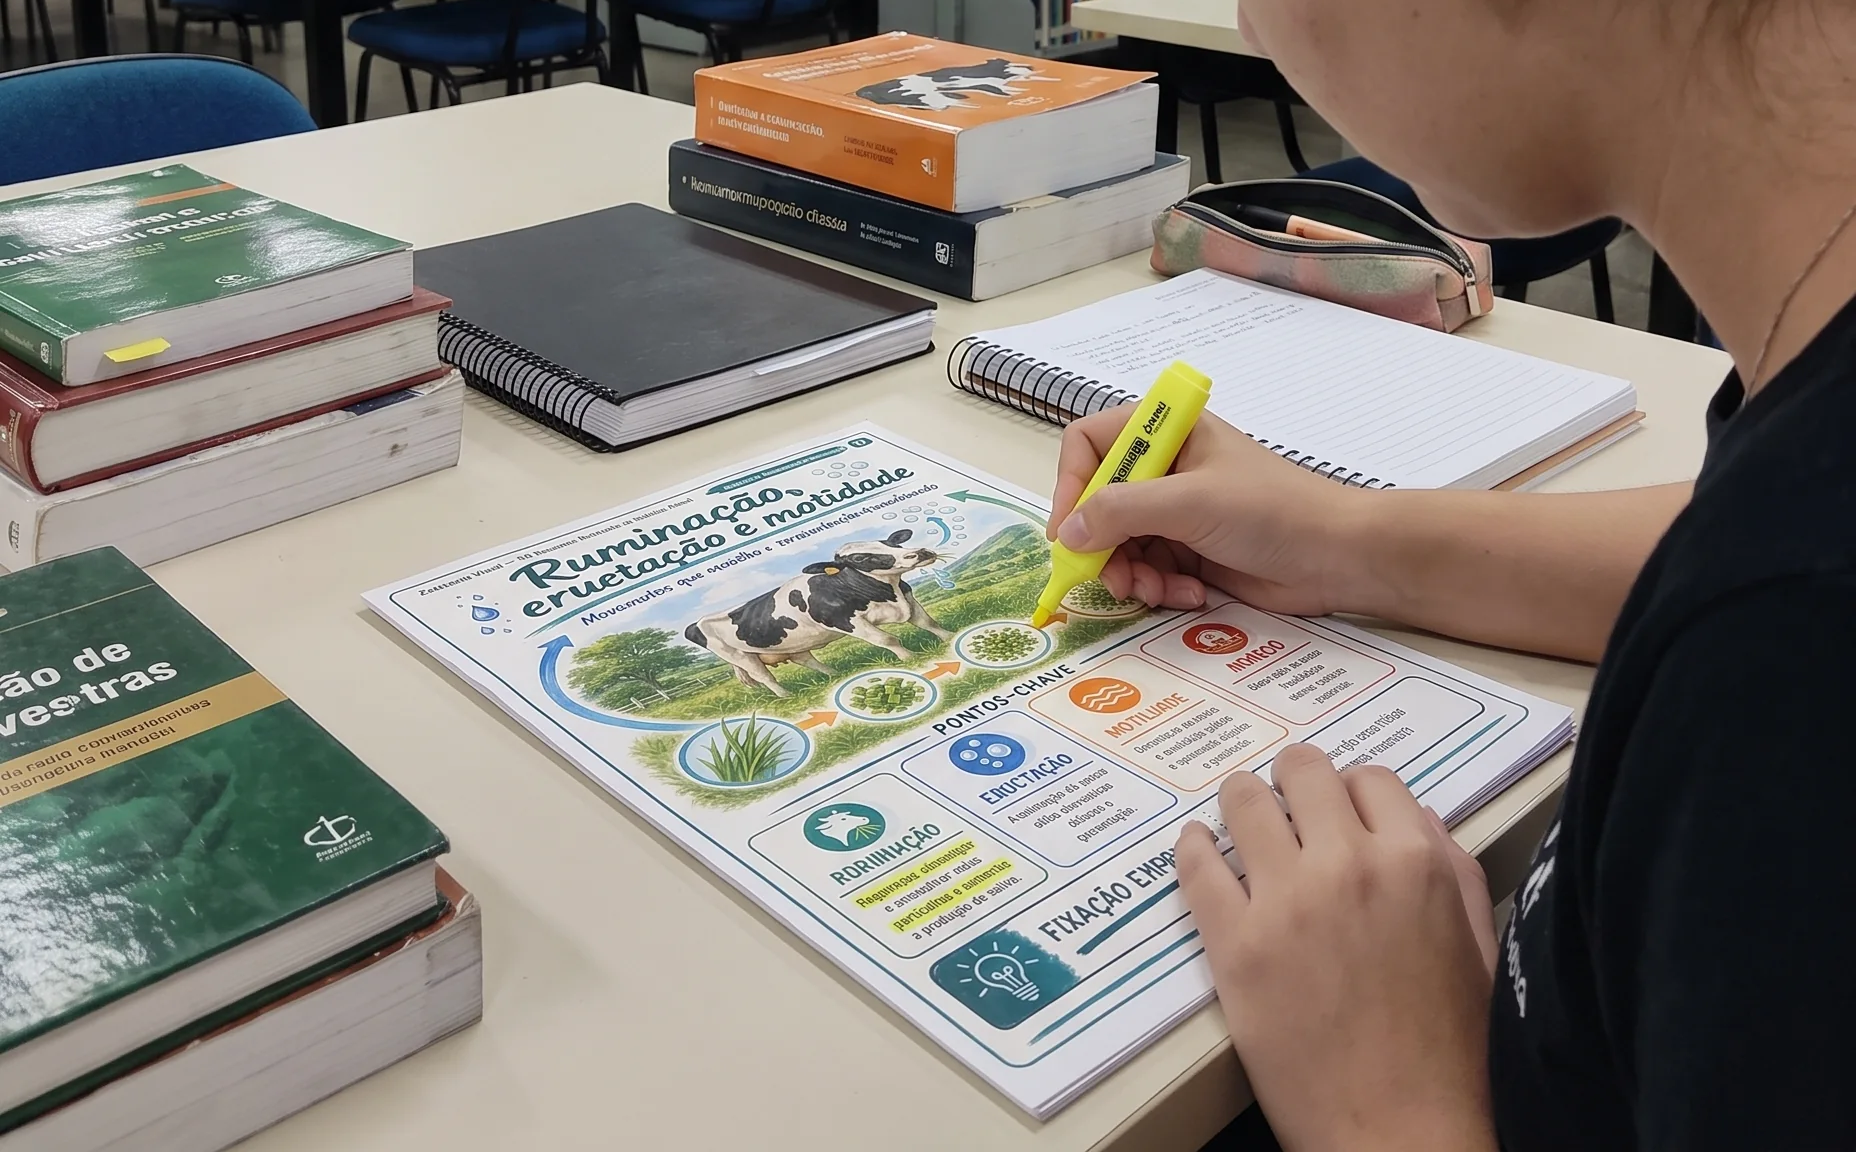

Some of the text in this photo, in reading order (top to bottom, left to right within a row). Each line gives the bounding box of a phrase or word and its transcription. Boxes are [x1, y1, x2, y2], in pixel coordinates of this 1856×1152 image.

[734, 520, 758, 537] e
[72, 642, 132, 673] de
[932, 664, 1076, 736] PONTOS-CHAVE
[1037, 882, 1132, 942] FIXAÇÃO
